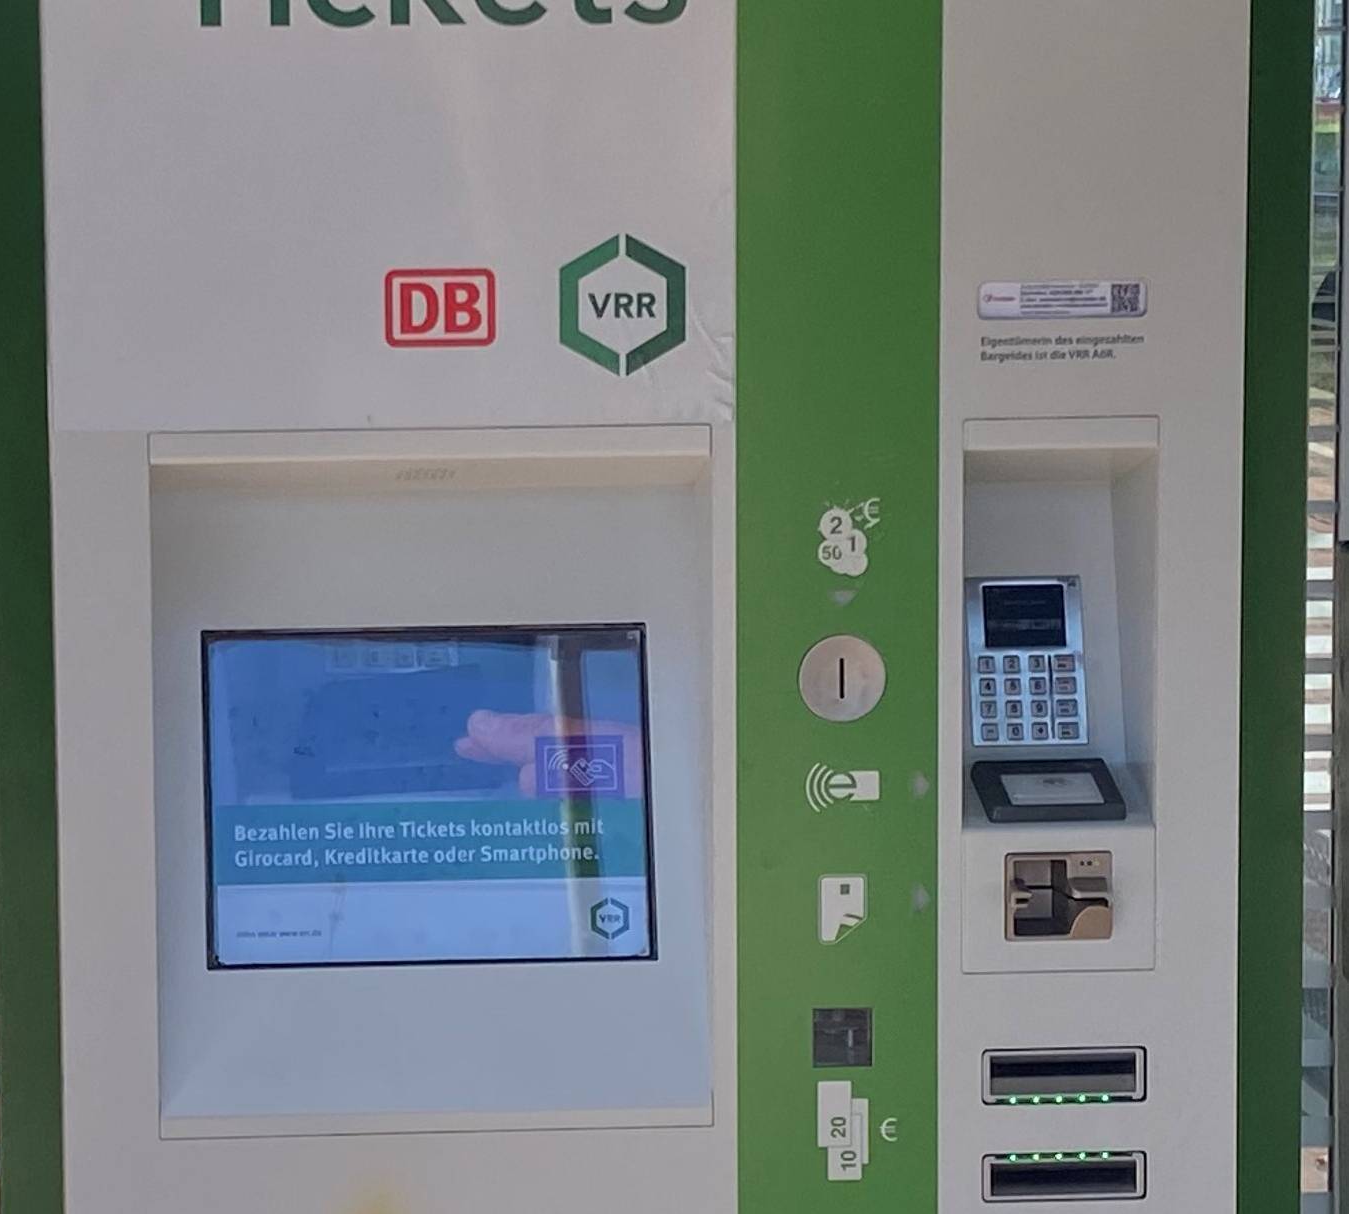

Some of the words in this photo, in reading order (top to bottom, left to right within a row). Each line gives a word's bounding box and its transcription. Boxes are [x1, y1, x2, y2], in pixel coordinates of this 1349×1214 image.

[399, 281, 483, 335] DB
[587, 292, 657, 319] VRR
[1054, 334, 1073, 345] des
[1076, 333, 1145, 348] eingezahlten
[1034, 350, 1048, 360] ist
[1049, 349, 1067, 360] die
[1068, 348, 1091, 361] VRR
[829, 516, 843, 535] 2
[821, 545, 843, 561] 50
[848, 536, 856, 553] 1
[234, 823, 320, 842] Bezahlen
[324, 822, 355, 840] Sie
[358, 822, 395, 839] Ihre
[399, 820, 466, 839] Tickets
[470, 818, 570, 837] kontaktlos
[574, 818, 604, 835] mit
[234, 849, 320, 868] Girocard,
[325, 846, 429, 865] Kreditkarte
[433, 846, 476, 864] oder
[480, 843, 600, 865] Smartphone.
[830, 1116, 847, 1138] 20
[840, 1150, 857, 1171] 10
